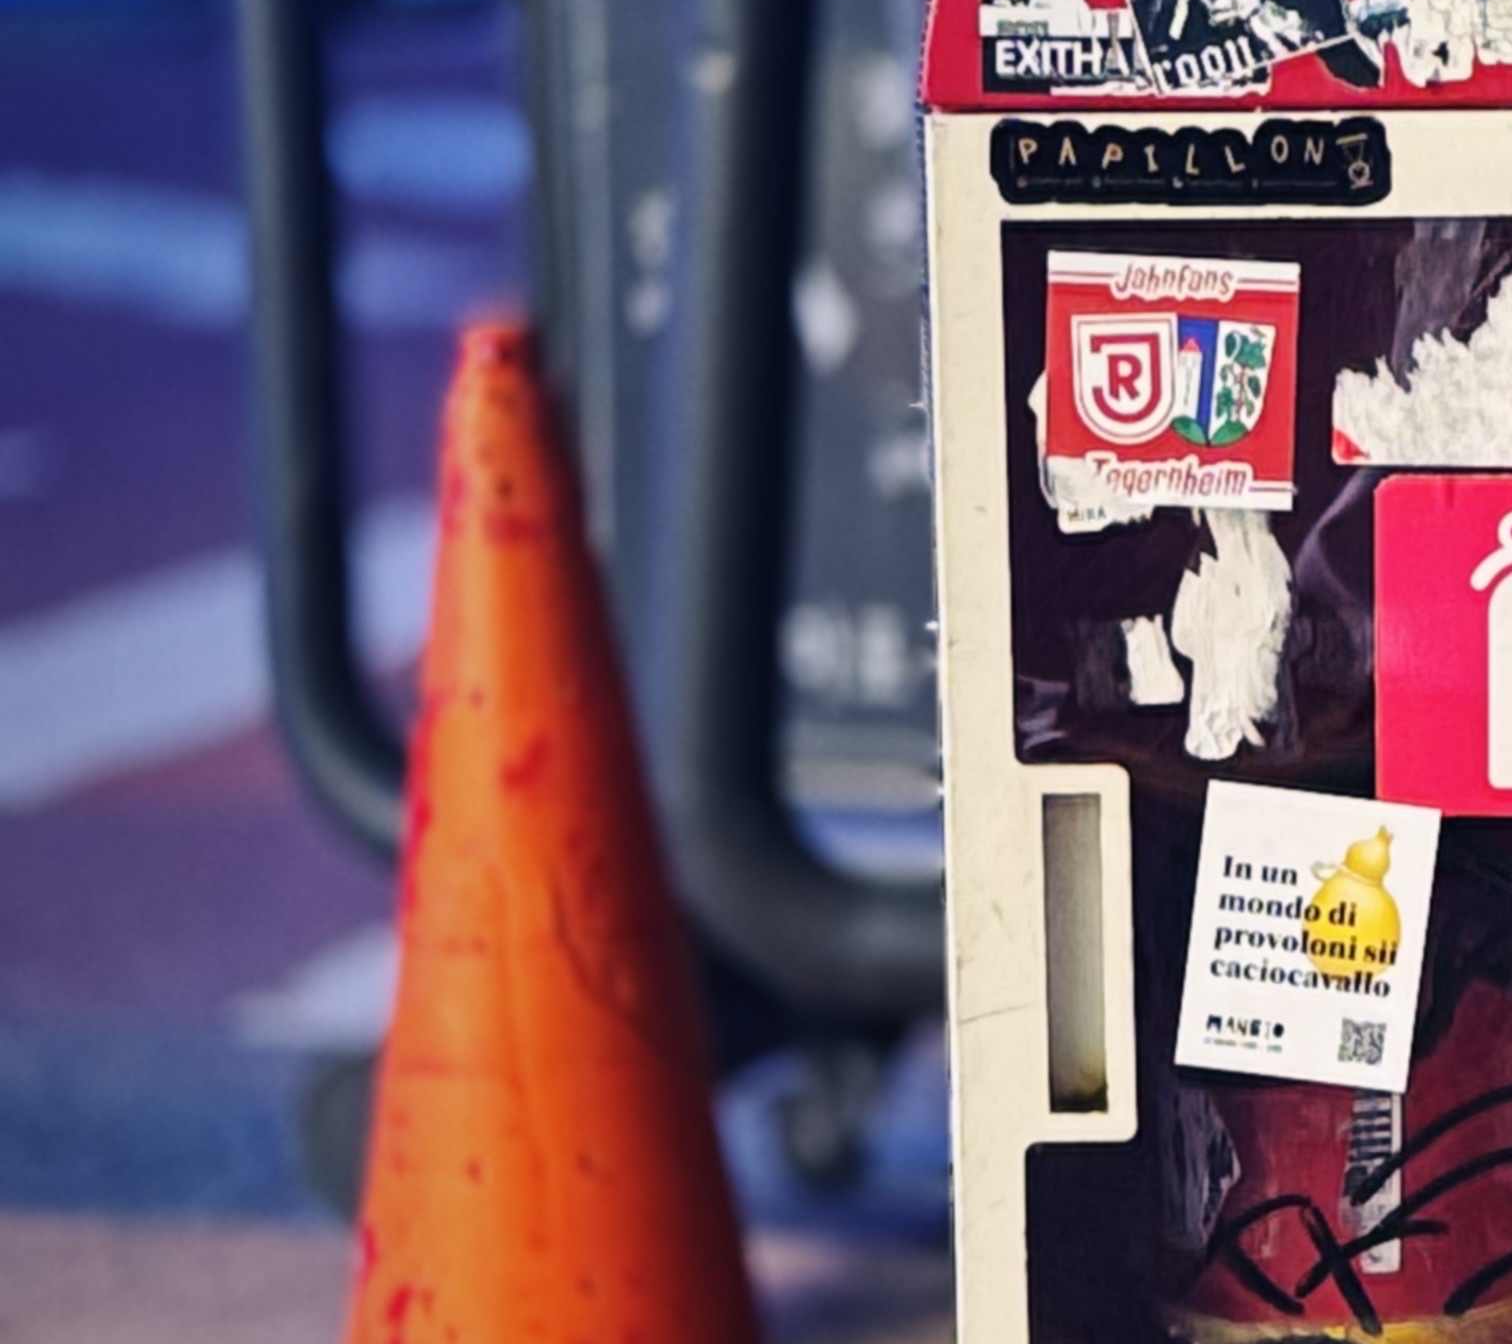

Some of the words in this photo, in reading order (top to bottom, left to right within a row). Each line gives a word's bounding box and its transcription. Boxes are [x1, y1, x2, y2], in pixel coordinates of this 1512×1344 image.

[1018, 134, 1325, 175] PAPILLON
[1223, 854, 1252, 880] In
[1261, 864, 1298, 886] un
[1218, 892, 1321, 924] mondo
[1328, 901, 1357, 928] di
[1213, 926, 1358, 962] provoloni
[1363, 939, 1398, 966] sii
[1209, 957, 1391, 999] caciocavallo
